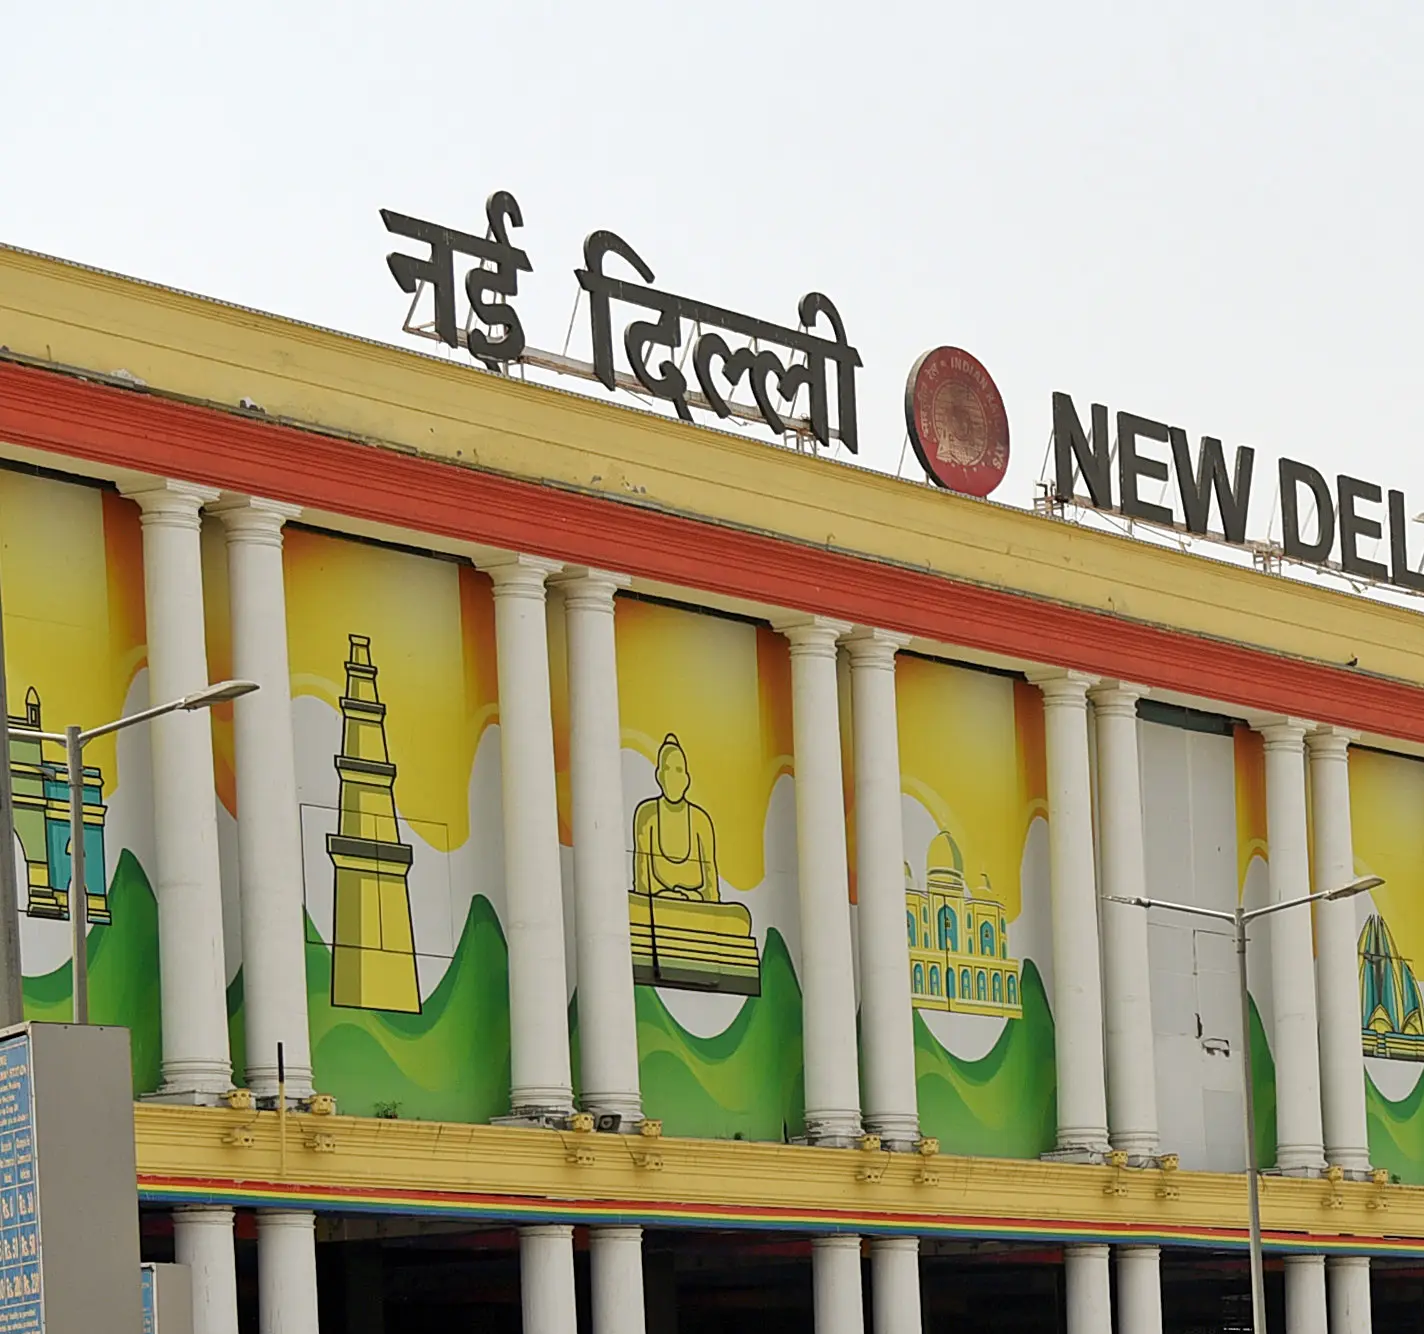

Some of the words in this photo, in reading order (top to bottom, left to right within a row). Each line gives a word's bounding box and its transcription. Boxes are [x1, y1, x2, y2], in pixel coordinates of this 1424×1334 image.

[379, 190, 533, 373] नई
[574, 229, 863, 455] दिल्ली
[1052, 391, 1255, 544] NEW
